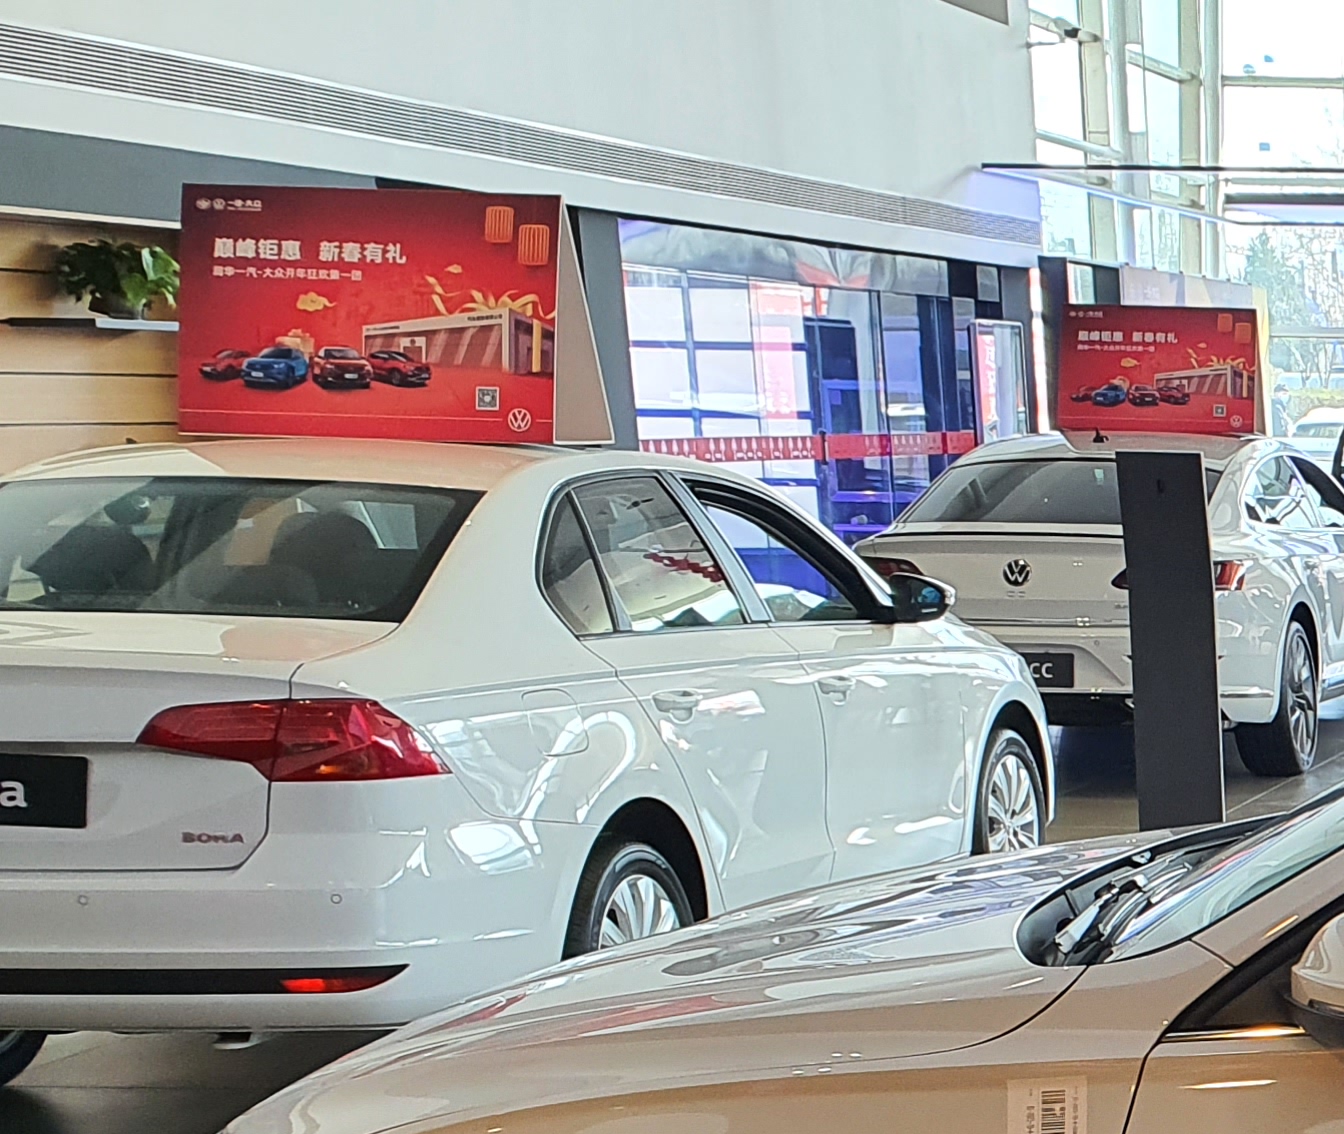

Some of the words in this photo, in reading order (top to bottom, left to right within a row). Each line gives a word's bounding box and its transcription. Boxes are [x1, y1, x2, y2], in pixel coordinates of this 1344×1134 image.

[213, 237, 302, 261] 巅峰钜惠
[318, 240, 407, 264] 新春有礼
[1030, 662, 1053, 678] CC
[181, 832, 244, 845] BORA
